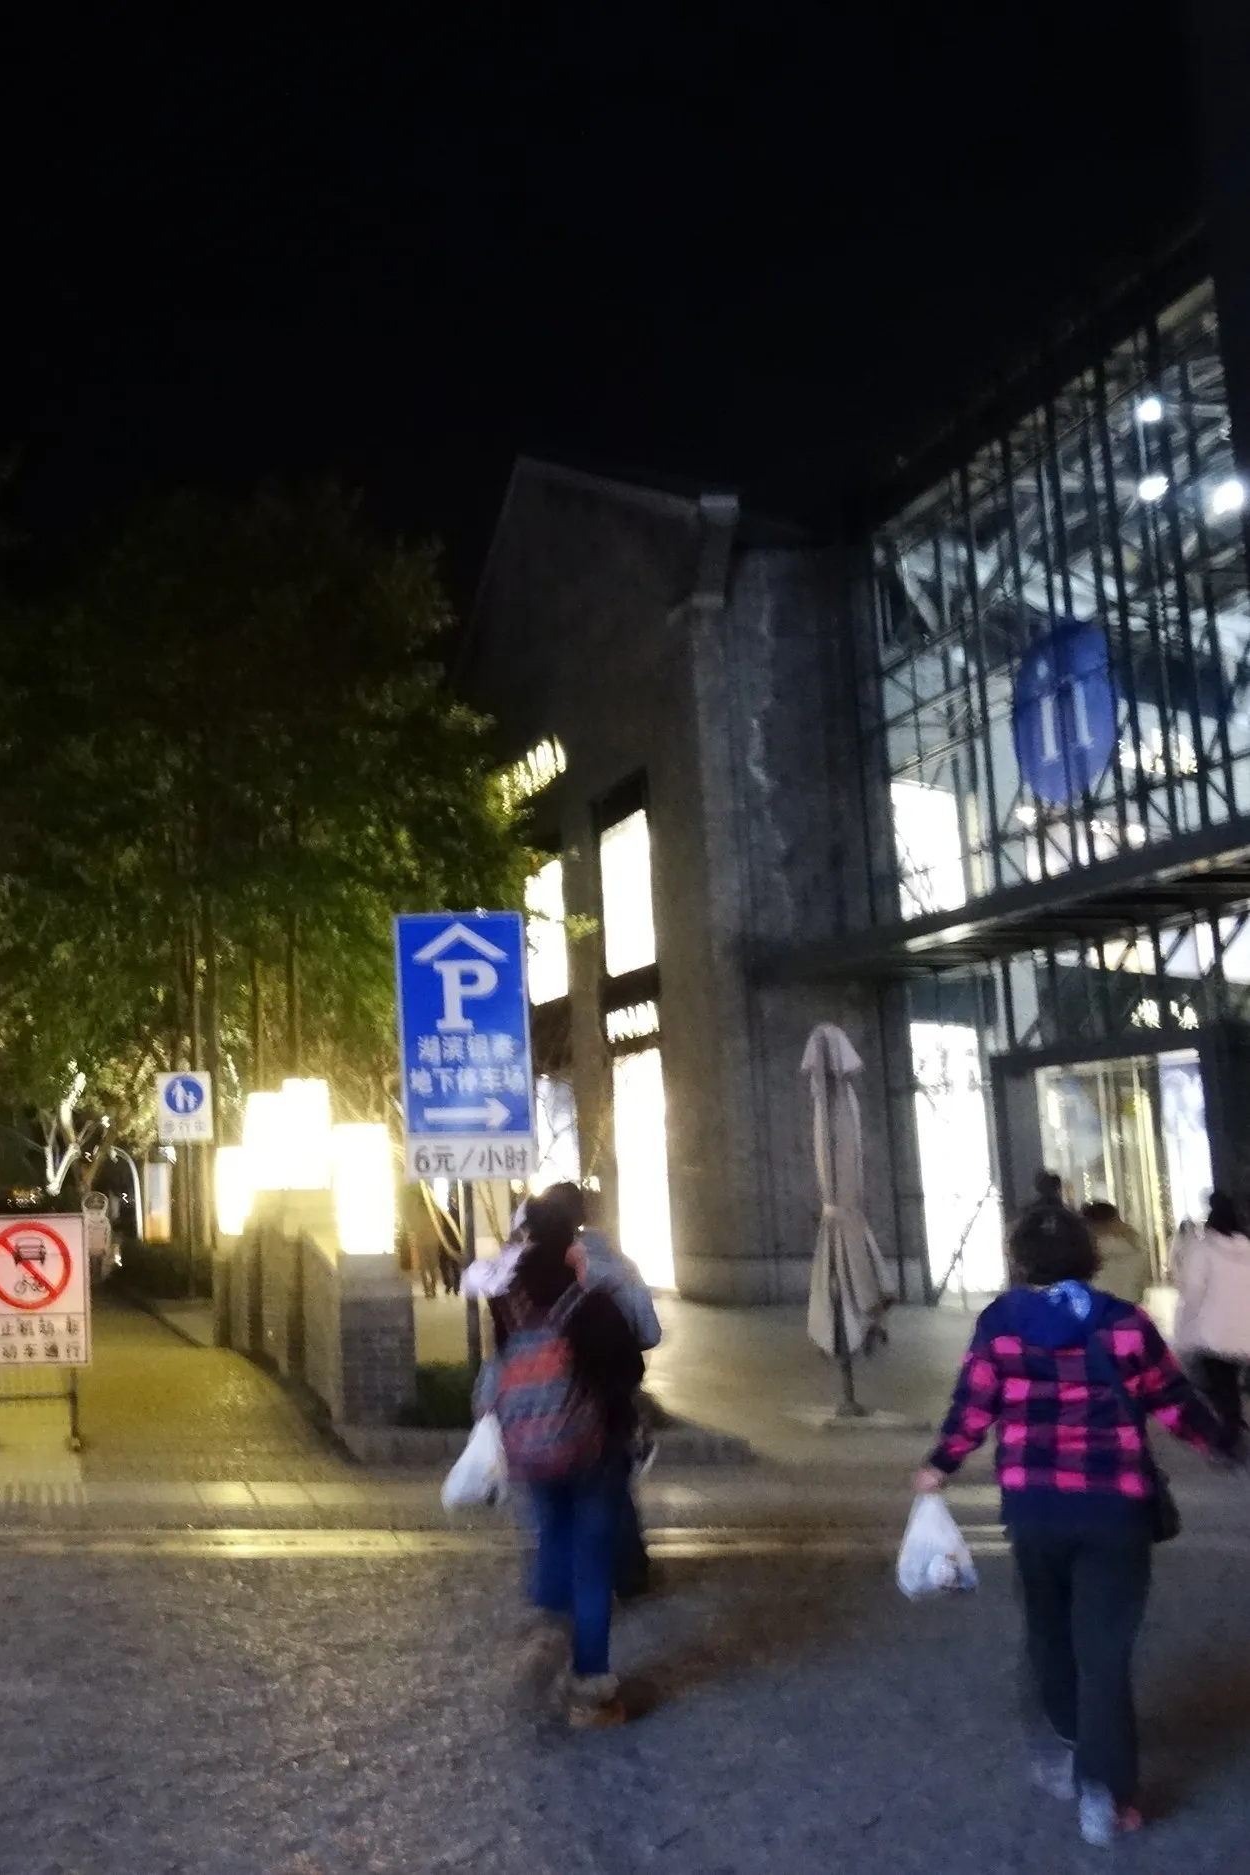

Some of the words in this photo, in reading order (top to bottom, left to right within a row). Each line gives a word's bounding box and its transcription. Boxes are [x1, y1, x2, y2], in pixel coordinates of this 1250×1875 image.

[433, 959, 498, 1032] P
[410, 1065, 526, 1096] 地下停车场
[414, 1144, 528, 1174] 6元/小时
